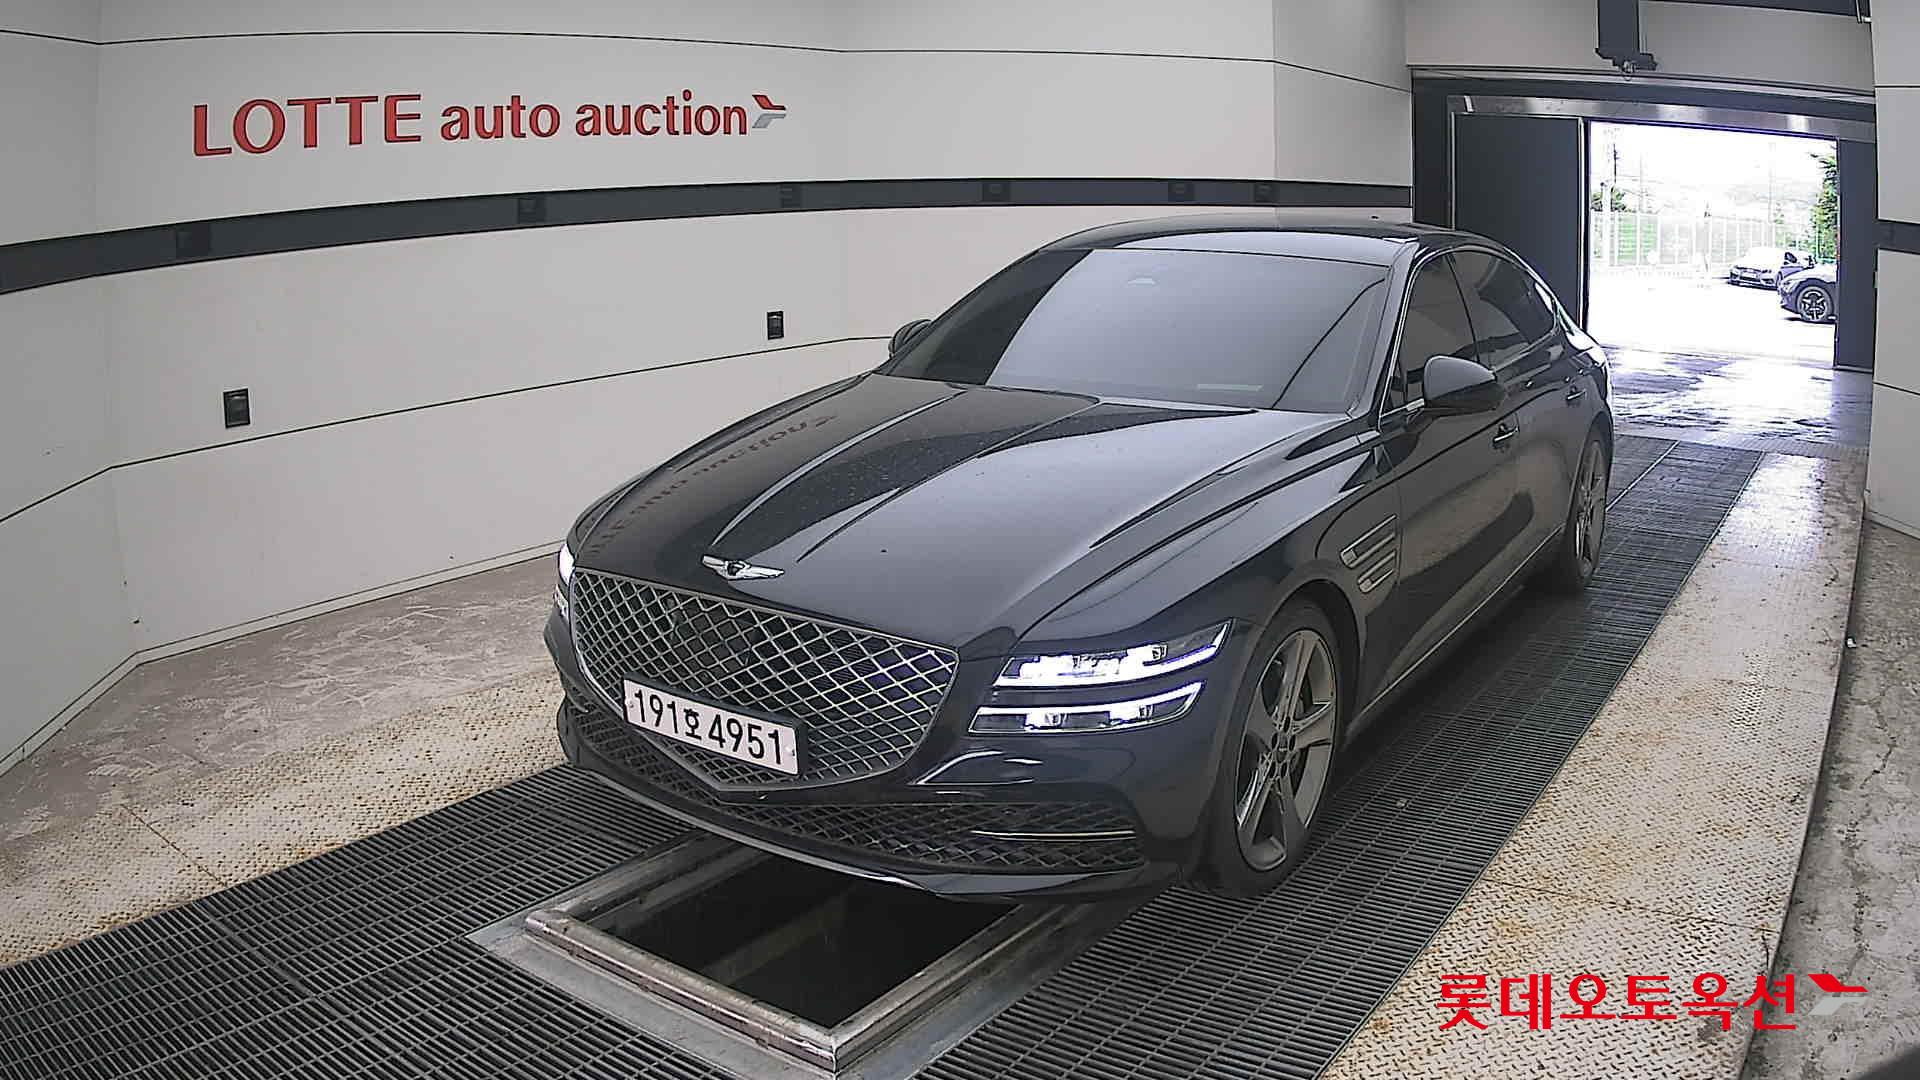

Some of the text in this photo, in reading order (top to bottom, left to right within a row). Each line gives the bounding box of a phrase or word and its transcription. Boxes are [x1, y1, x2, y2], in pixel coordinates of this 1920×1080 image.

[193, 88, 749, 157] LOTTE auto auction
